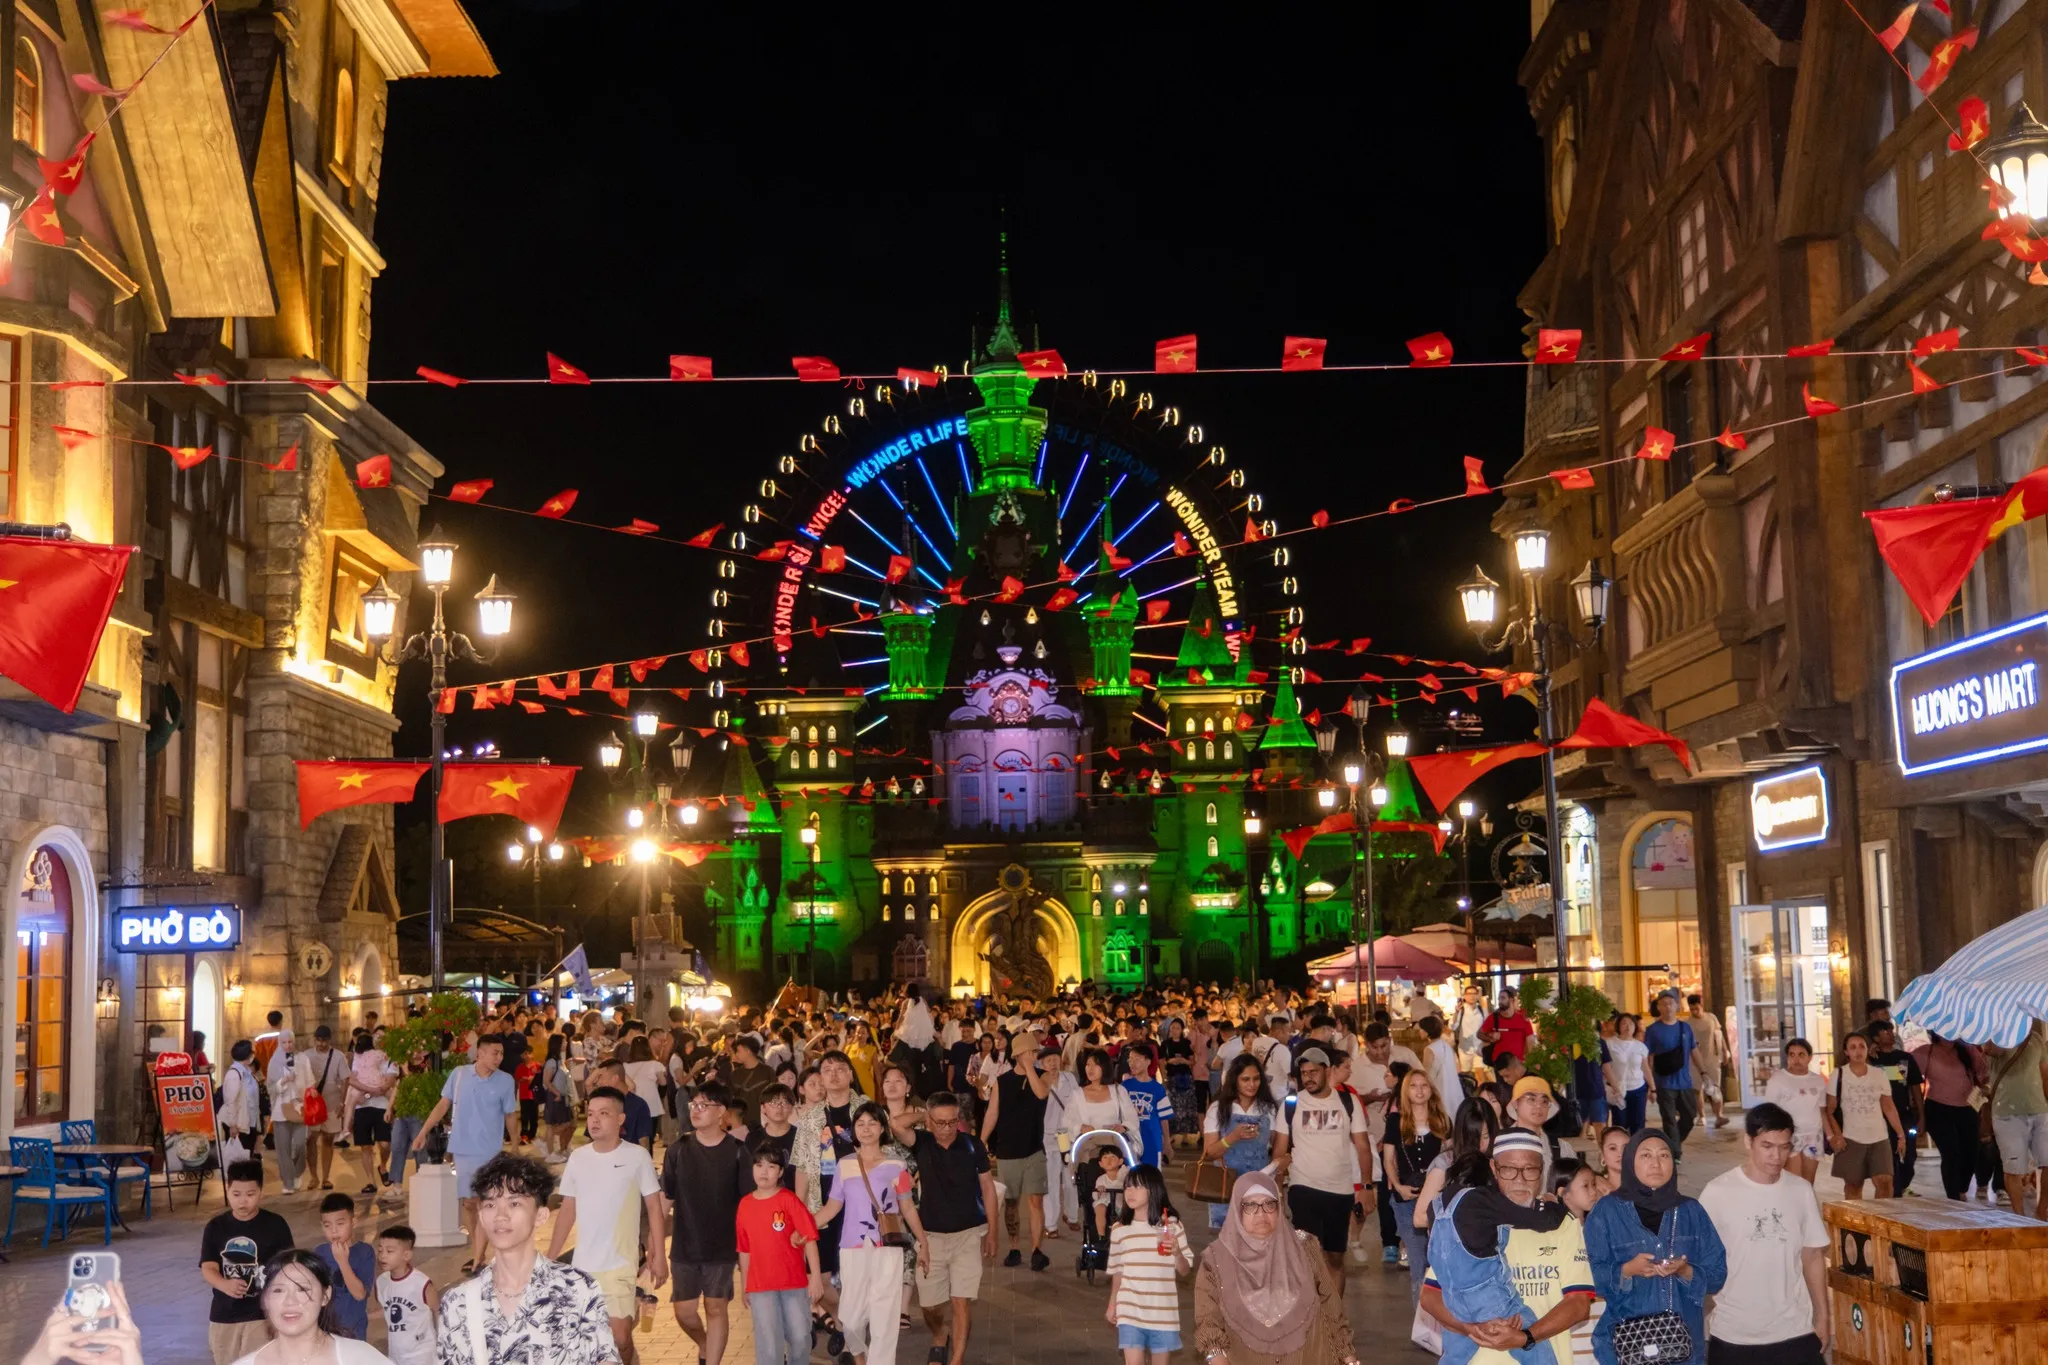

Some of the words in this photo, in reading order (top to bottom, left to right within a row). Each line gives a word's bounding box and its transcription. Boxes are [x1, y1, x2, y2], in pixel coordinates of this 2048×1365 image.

[847, 431, 927, 489] WONDER
[926, 418, 969, 444] LIFE
[1165, 486, 1222, 565] WONDER
[1212, 562, 1239, 617] TEAM
[1911, 677, 1984, 735] HUONG'S
[1984, 662, 2035, 716] MART
[1505, 882, 1552, 905] Fairy
[121, 909, 184, 945] PHỞ
[188, 909, 232, 943] BÒ
[164, 1079, 206, 1103] PHỞ
[1520, 1282, 1550, 1297] BETTER
